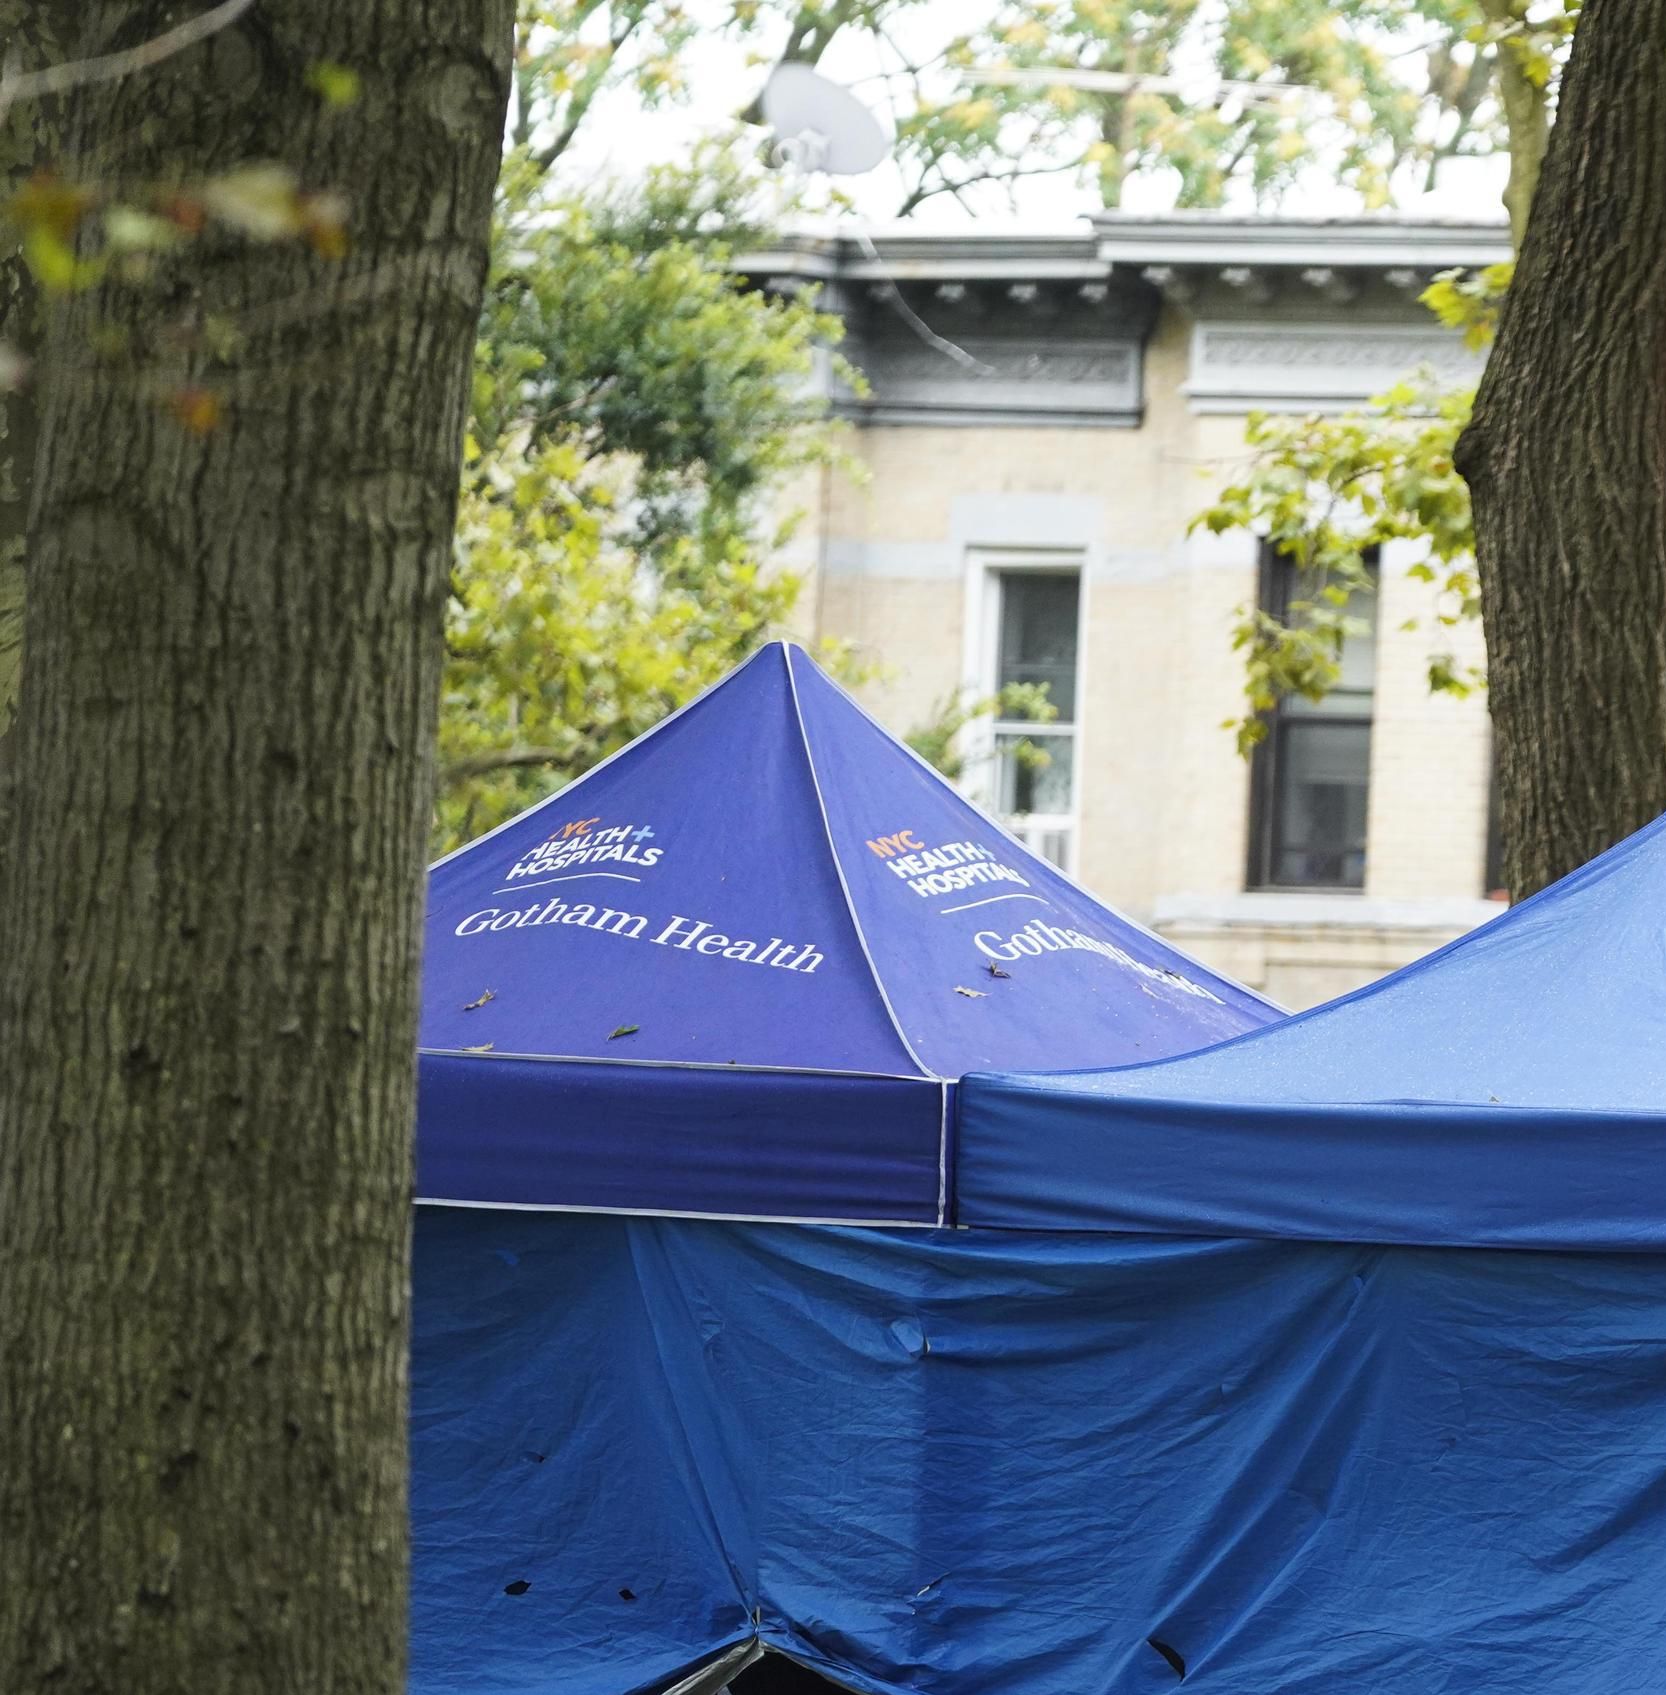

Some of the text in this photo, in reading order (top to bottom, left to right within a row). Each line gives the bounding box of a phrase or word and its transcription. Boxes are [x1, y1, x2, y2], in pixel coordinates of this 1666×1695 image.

[549, 817, 601, 840] NYC
[865, 829, 925, 858] NYC
[506, 845, 664, 880] HOSPITALS
[454, 897, 824, 973] Gotham Health
